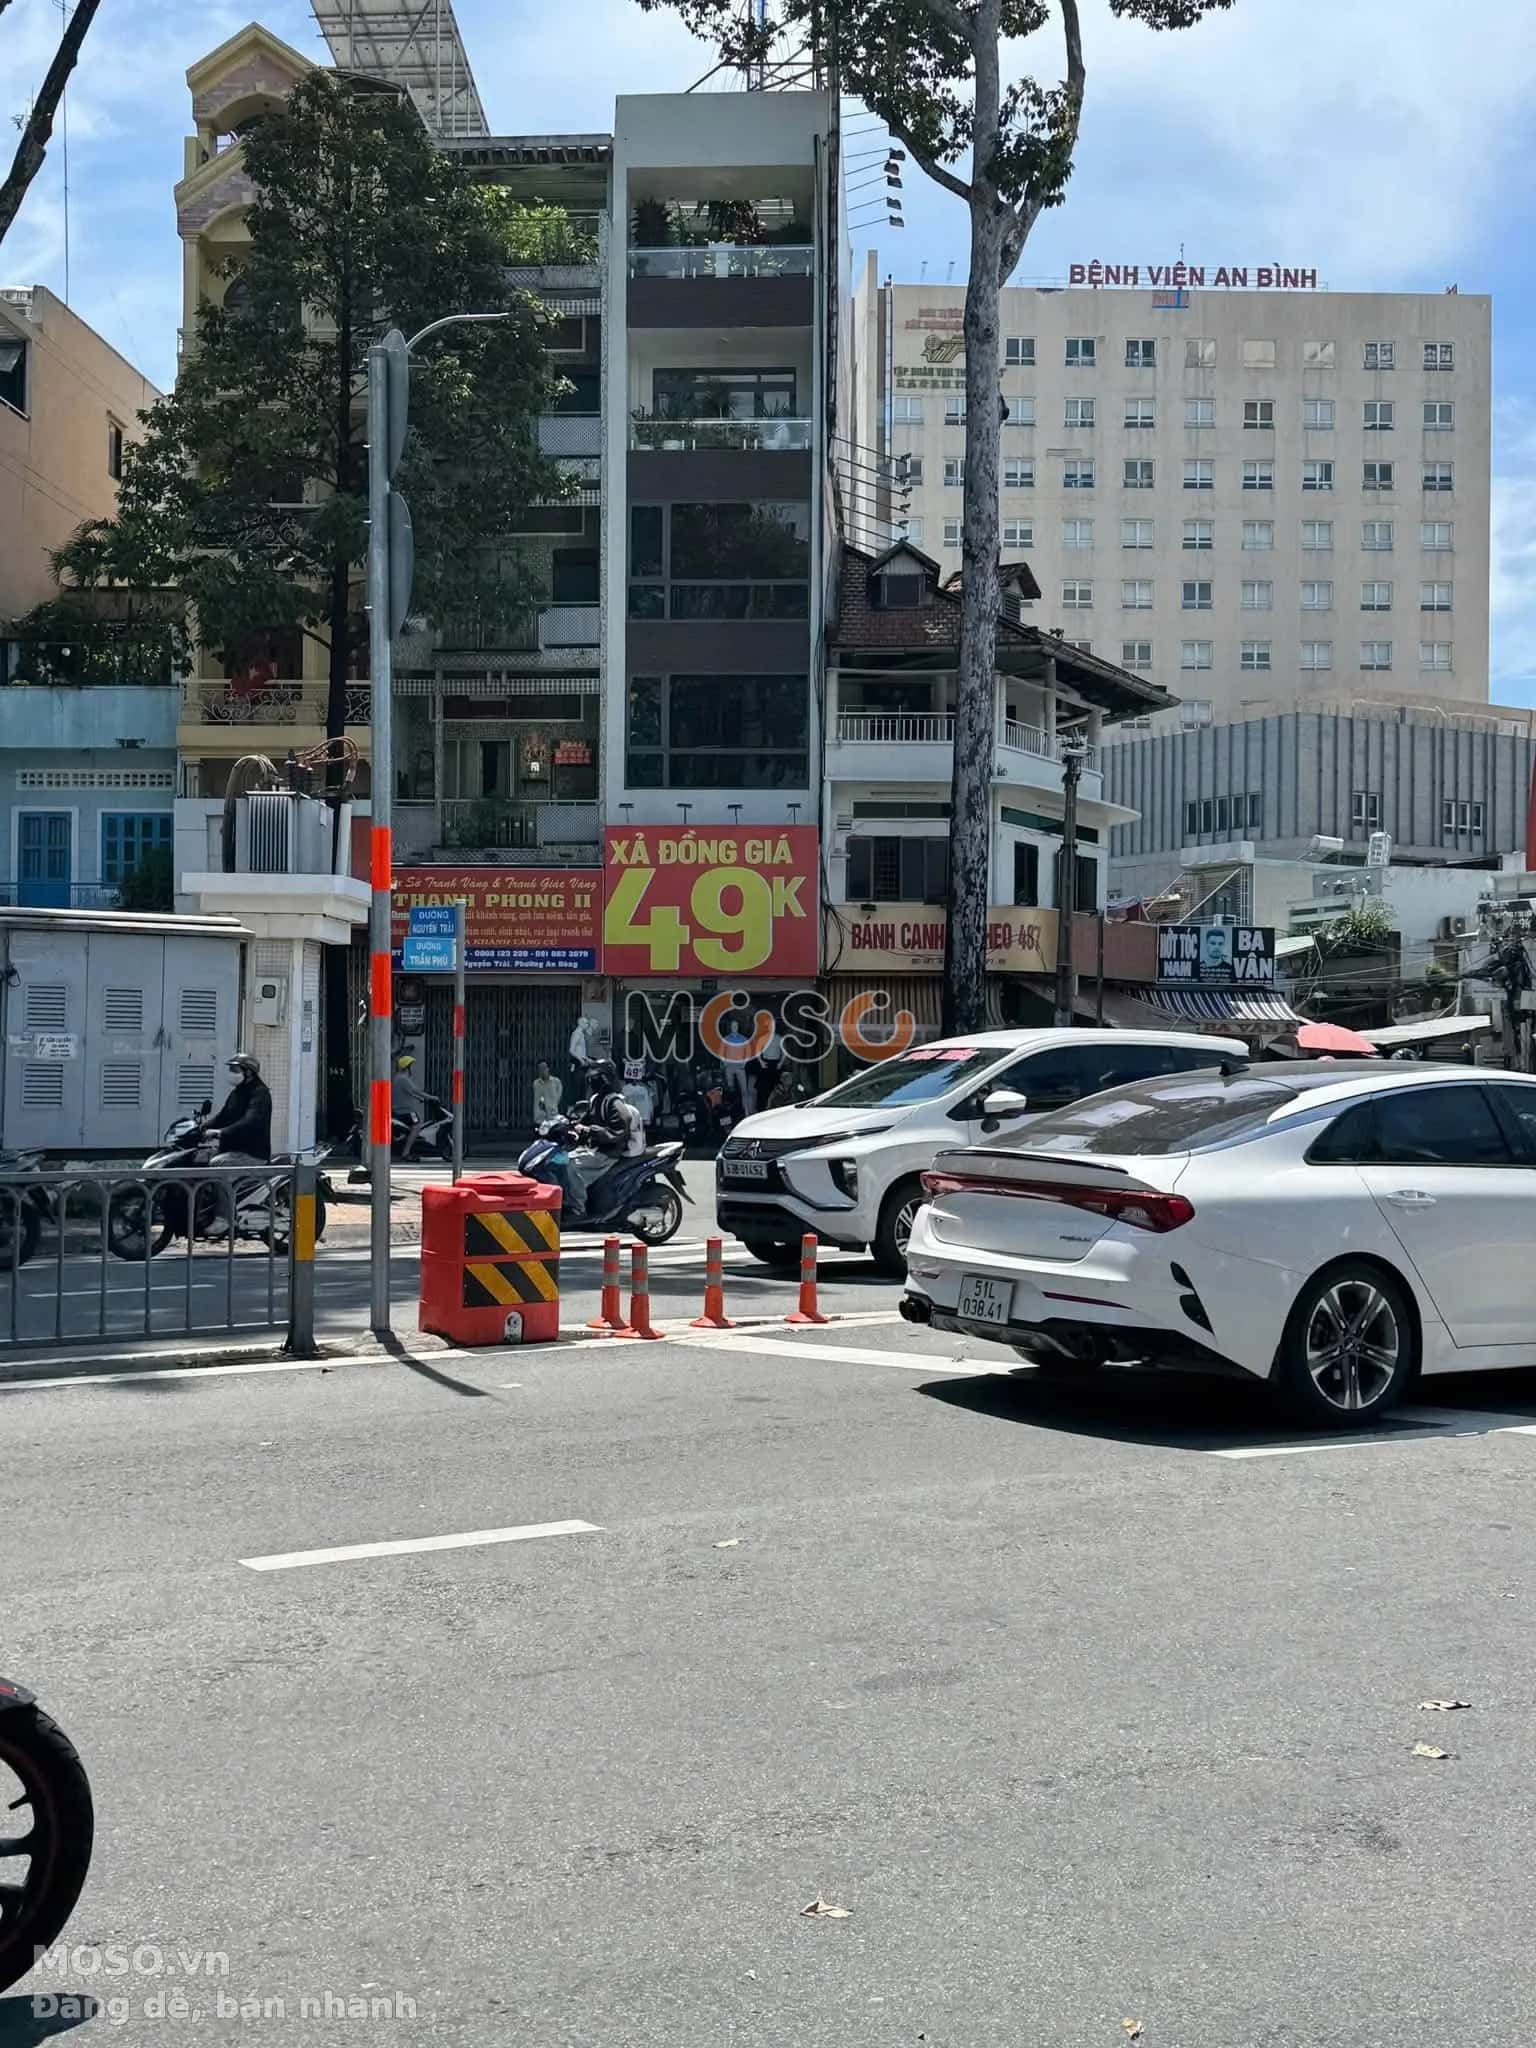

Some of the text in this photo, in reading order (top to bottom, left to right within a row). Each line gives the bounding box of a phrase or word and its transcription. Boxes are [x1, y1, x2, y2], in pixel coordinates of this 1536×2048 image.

[1069, 258, 1317, 291] BỆNH VIỆN AN BÌNH
[609, 829, 793, 865] XẢ ĐỒNG GIÁ
[392, 893, 592, 908] THANH PHONG II
[851, 915, 896, 950] BÁNH
[901, 923, 945, 950] CANH
[1237, 930, 1265, 952] BA
[1163, 961, 1193, 977] NAM
[1233, 952, 1274, 979] VÂN
[974, 1280, 995, 1299] 51L
[963, 1298, 1002, 1321] 038.41
